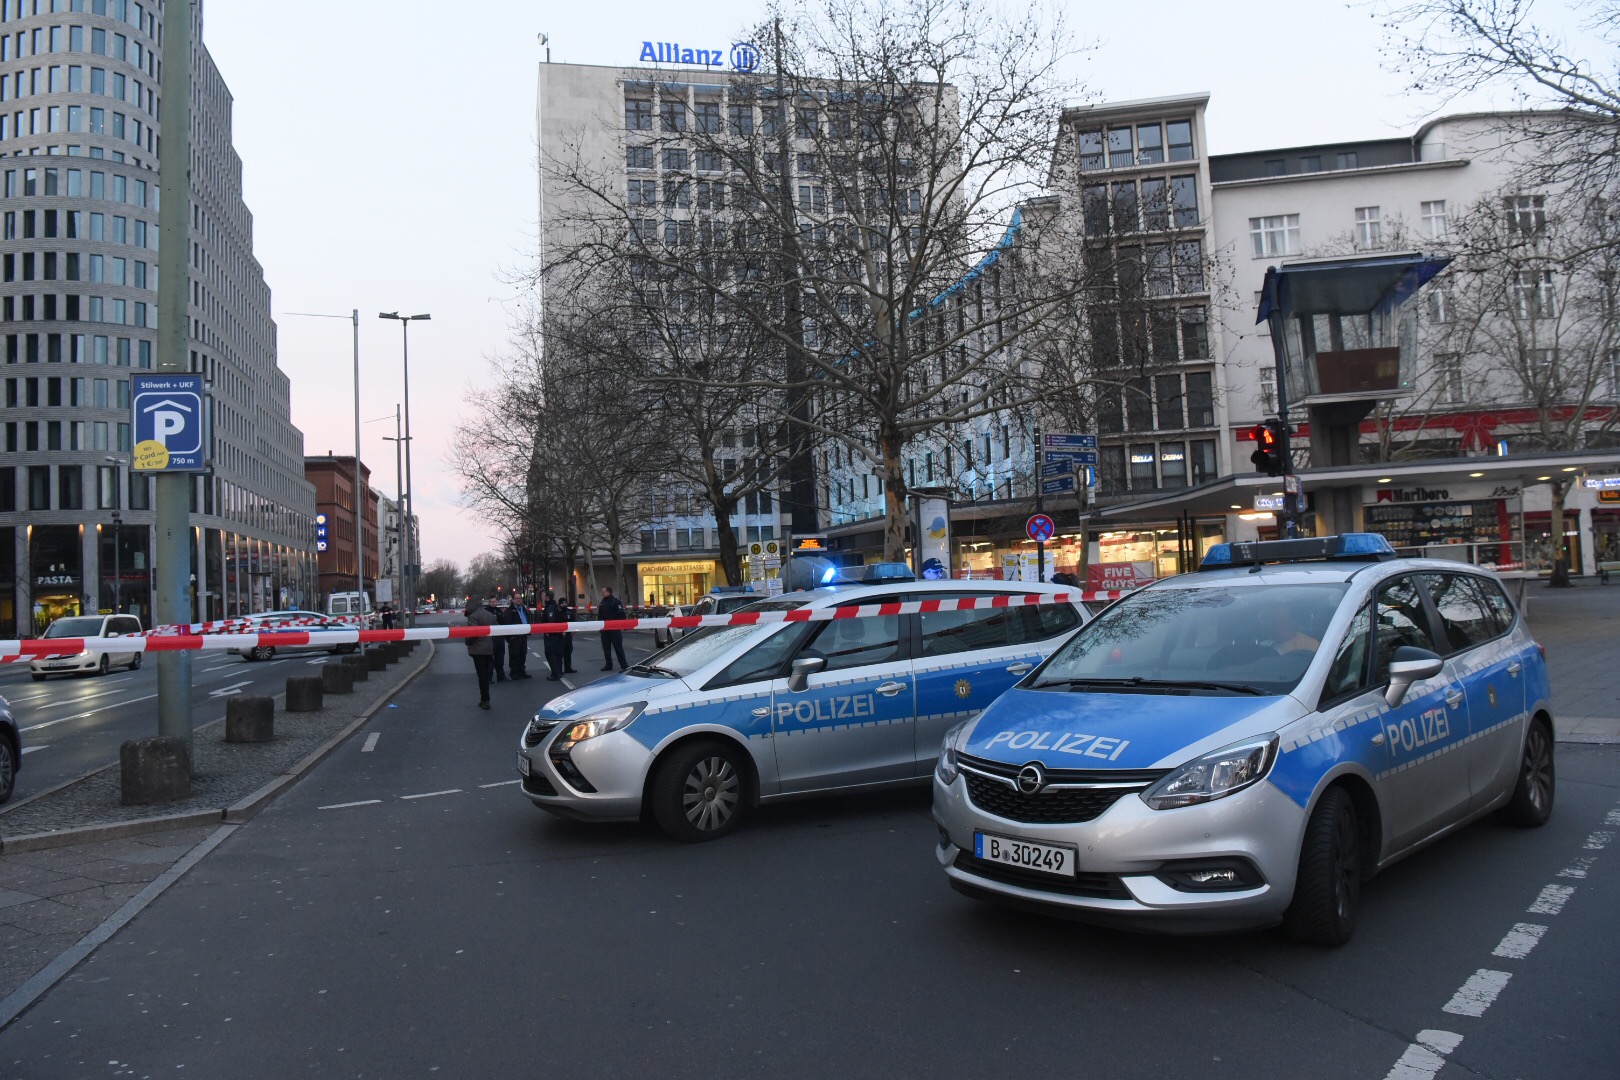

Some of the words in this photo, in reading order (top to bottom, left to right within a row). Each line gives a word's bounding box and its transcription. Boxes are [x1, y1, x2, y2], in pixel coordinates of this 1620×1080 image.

[640, 41, 723, 66] Allianz
[141, 381, 171, 389] Stilwerk
[154, 411, 185, 447] P
[140, 452, 155, 460] Card
[172, 457, 185, 465] 750
[1131, 455, 1154, 463] BELLA
[1393, 487, 1449, 501] Marlboro
[318, 528, 325, 537] H
[317, 541, 327, 549] 10
[641, 565, 682, 573] JOACHIMSTALER
[1104, 566, 1131, 578] FIVE
[37, 575, 73, 585] PASTA
[1102, 579, 1136, 590] GUYS
[777, 693, 875, 725] POLIZEI
[1386, 706, 1450, 757] POLIZEI
[984, 730, 1131, 761] POLIZEI
[991, 839, 1000, 859] B
[1011, 843, 1064, 871] 30249
